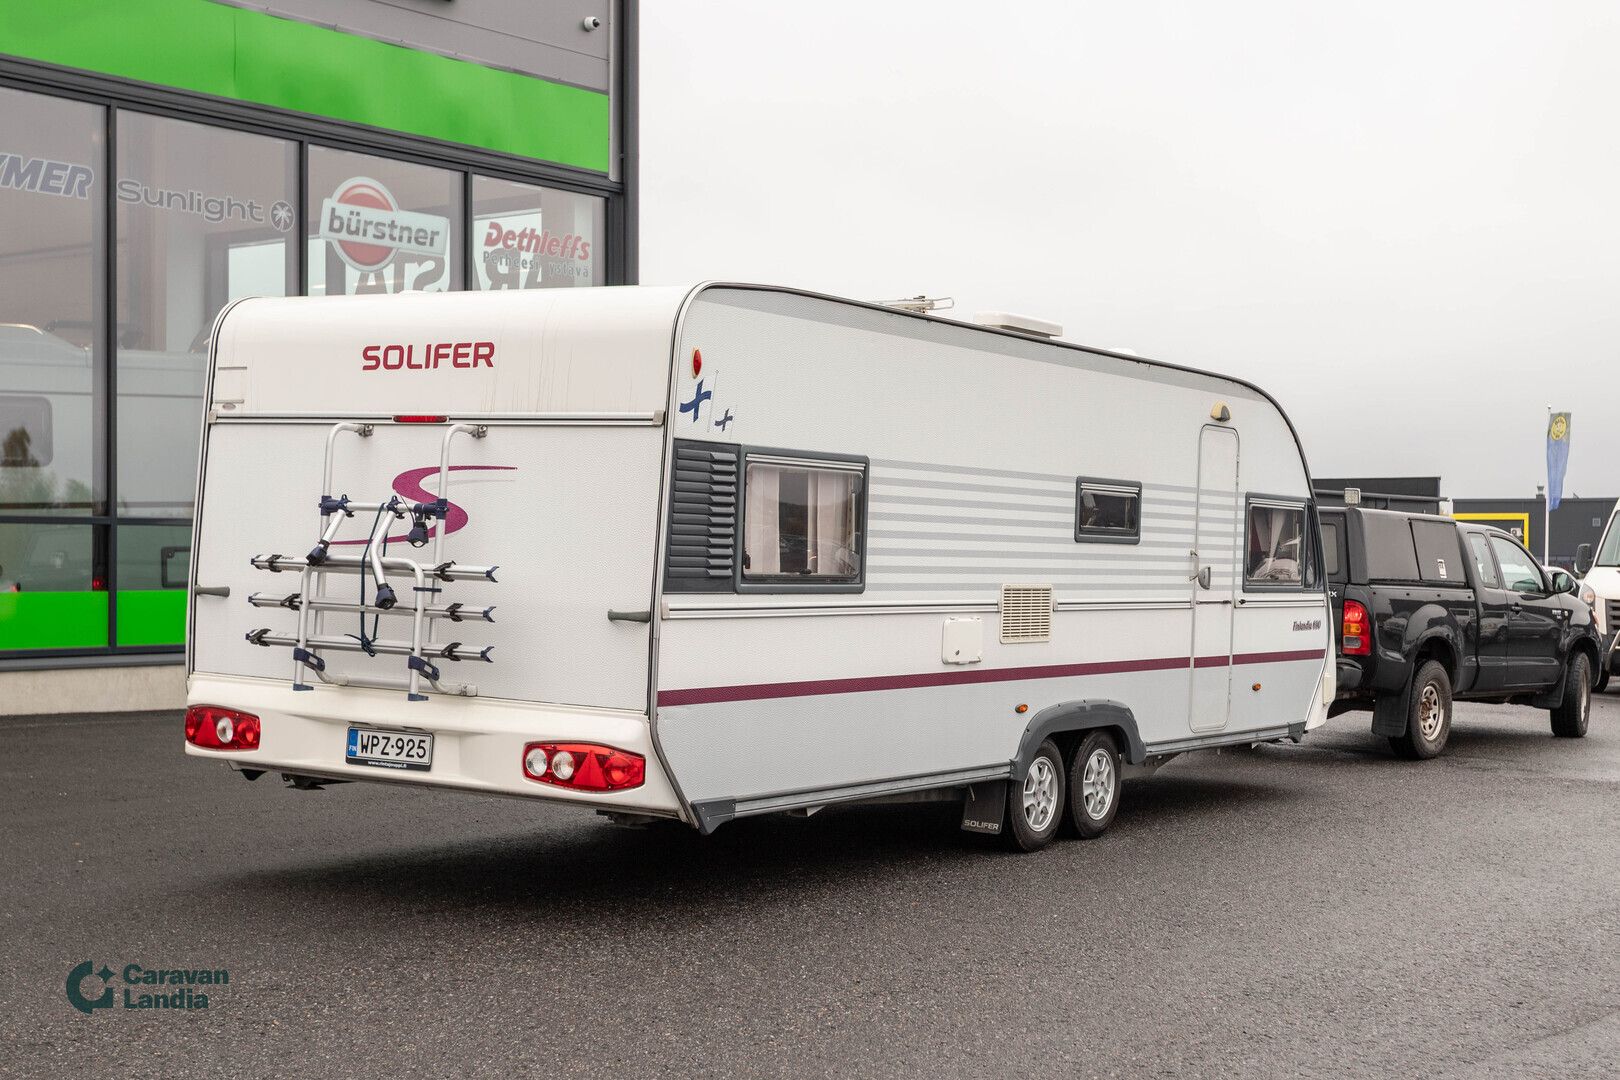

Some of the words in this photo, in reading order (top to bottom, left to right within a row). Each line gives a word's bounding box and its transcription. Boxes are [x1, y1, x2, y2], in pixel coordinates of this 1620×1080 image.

[117, 179, 264, 224] Sunlight
[328, 207, 440, 247] bürstner
[484, 221, 590, 260] Dethleffs
[362, 341, 495, 371] SOLIFER
[964, 819, 999, 830] SOLIFER
